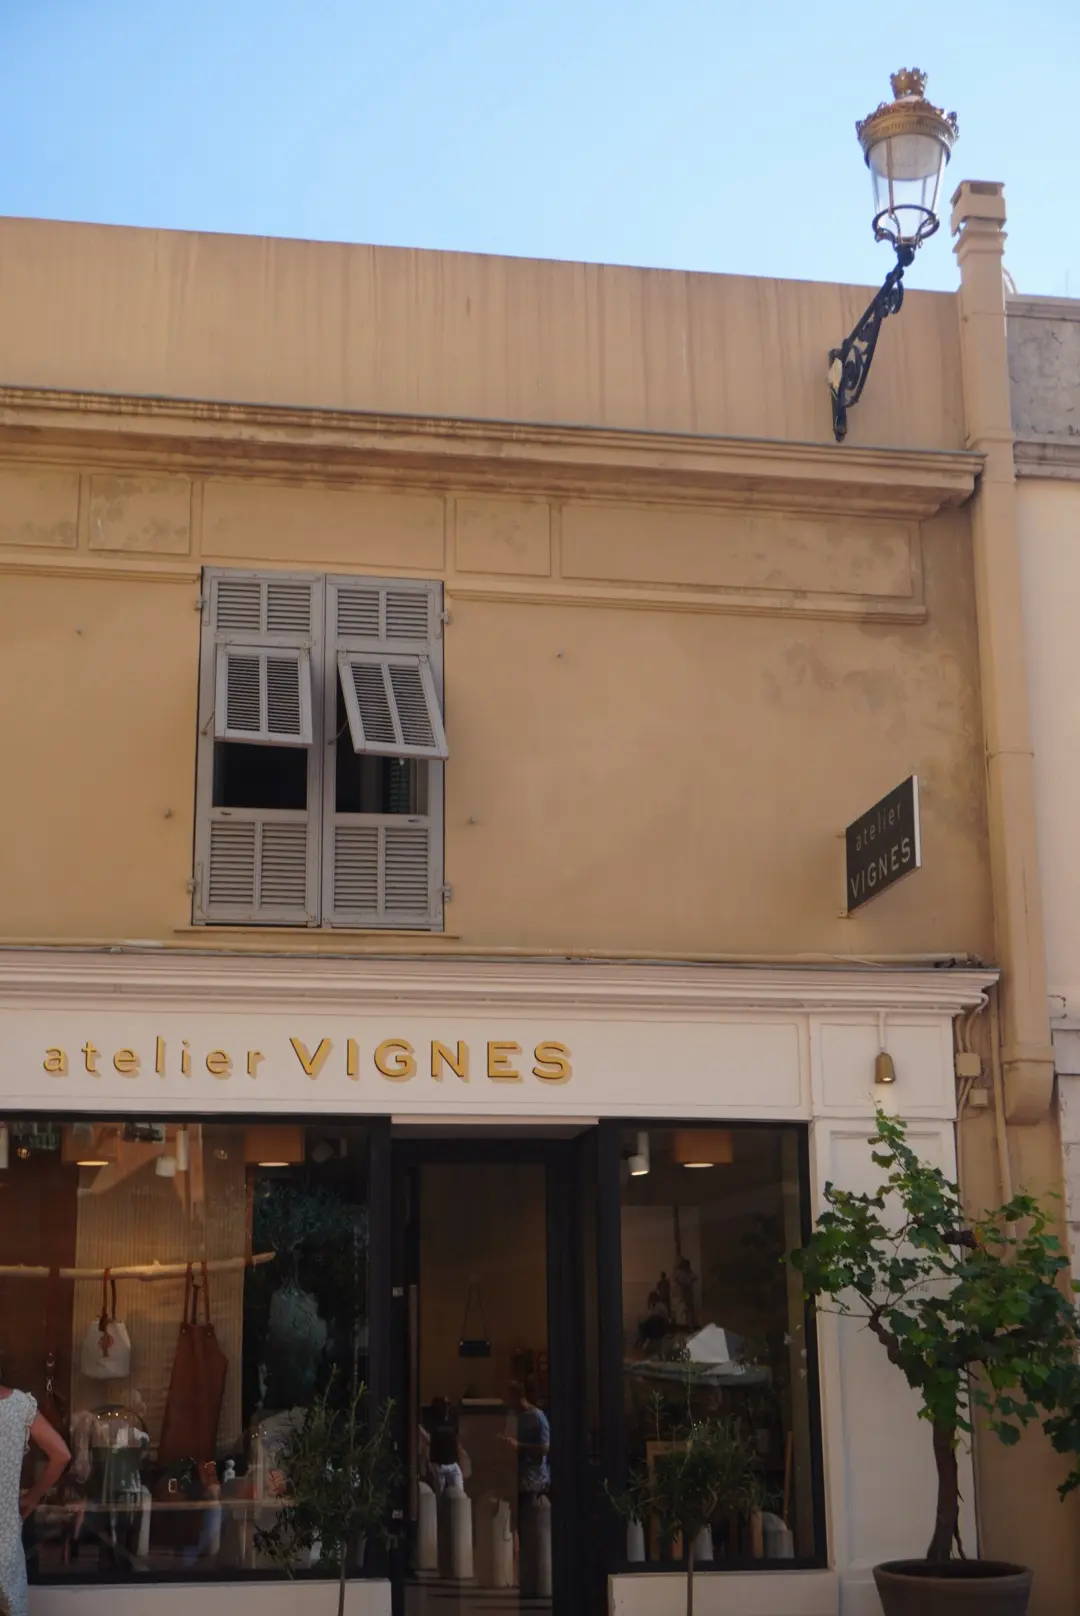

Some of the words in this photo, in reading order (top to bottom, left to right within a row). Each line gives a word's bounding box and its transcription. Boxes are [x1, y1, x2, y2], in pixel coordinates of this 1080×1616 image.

[856, 804, 901, 851] atelier
[850, 837, 911, 899] VIGNES
[43, 1035, 262, 1076] atelier
[289, 1037, 571, 1081] VIGNES
